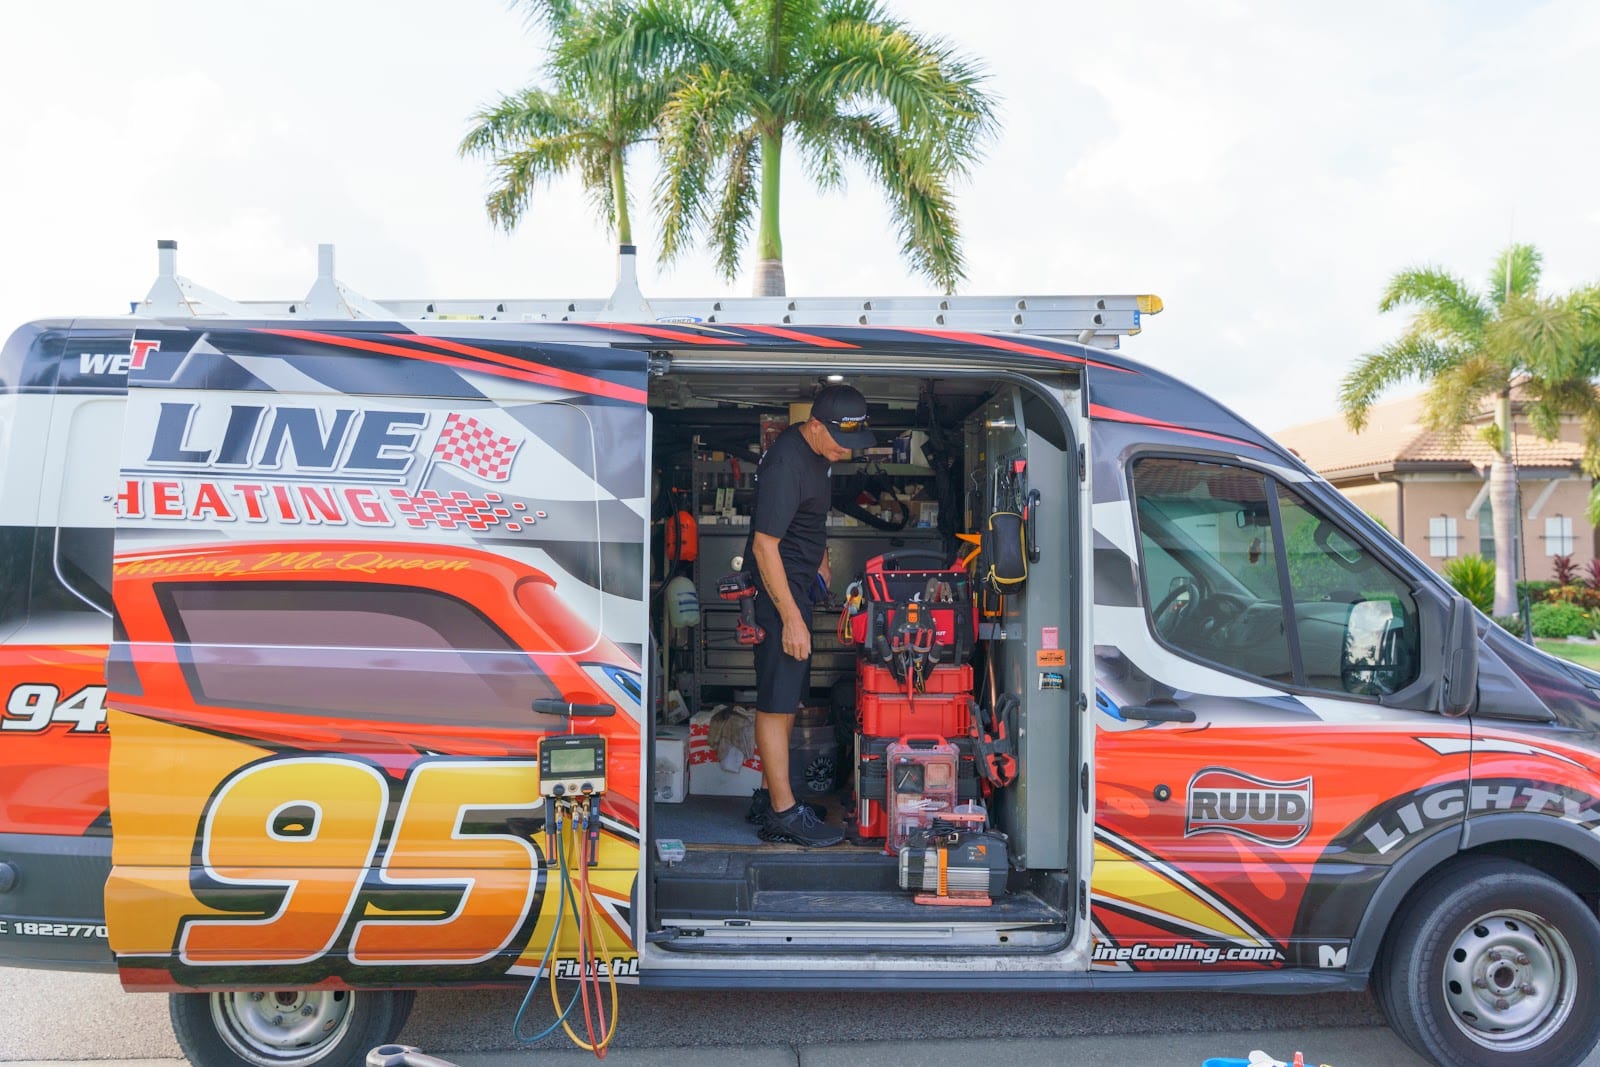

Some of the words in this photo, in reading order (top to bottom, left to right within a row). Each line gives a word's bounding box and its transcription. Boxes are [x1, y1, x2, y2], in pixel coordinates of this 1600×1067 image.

[145, 401, 431, 473] LINE
[116, 480, 393, 526] HEATING
[251, 551, 471, 574] McQueen
[1, 684, 110, 732] 94
[1191, 791, 1306, 821] RUUD
[1363, 786, 1600, 855] LIGHTY
[177, 756, 543, 967] 95
[14, 922, 109, 938] 1822770
[1091, 944, 1277, 964] ineCooling.com
